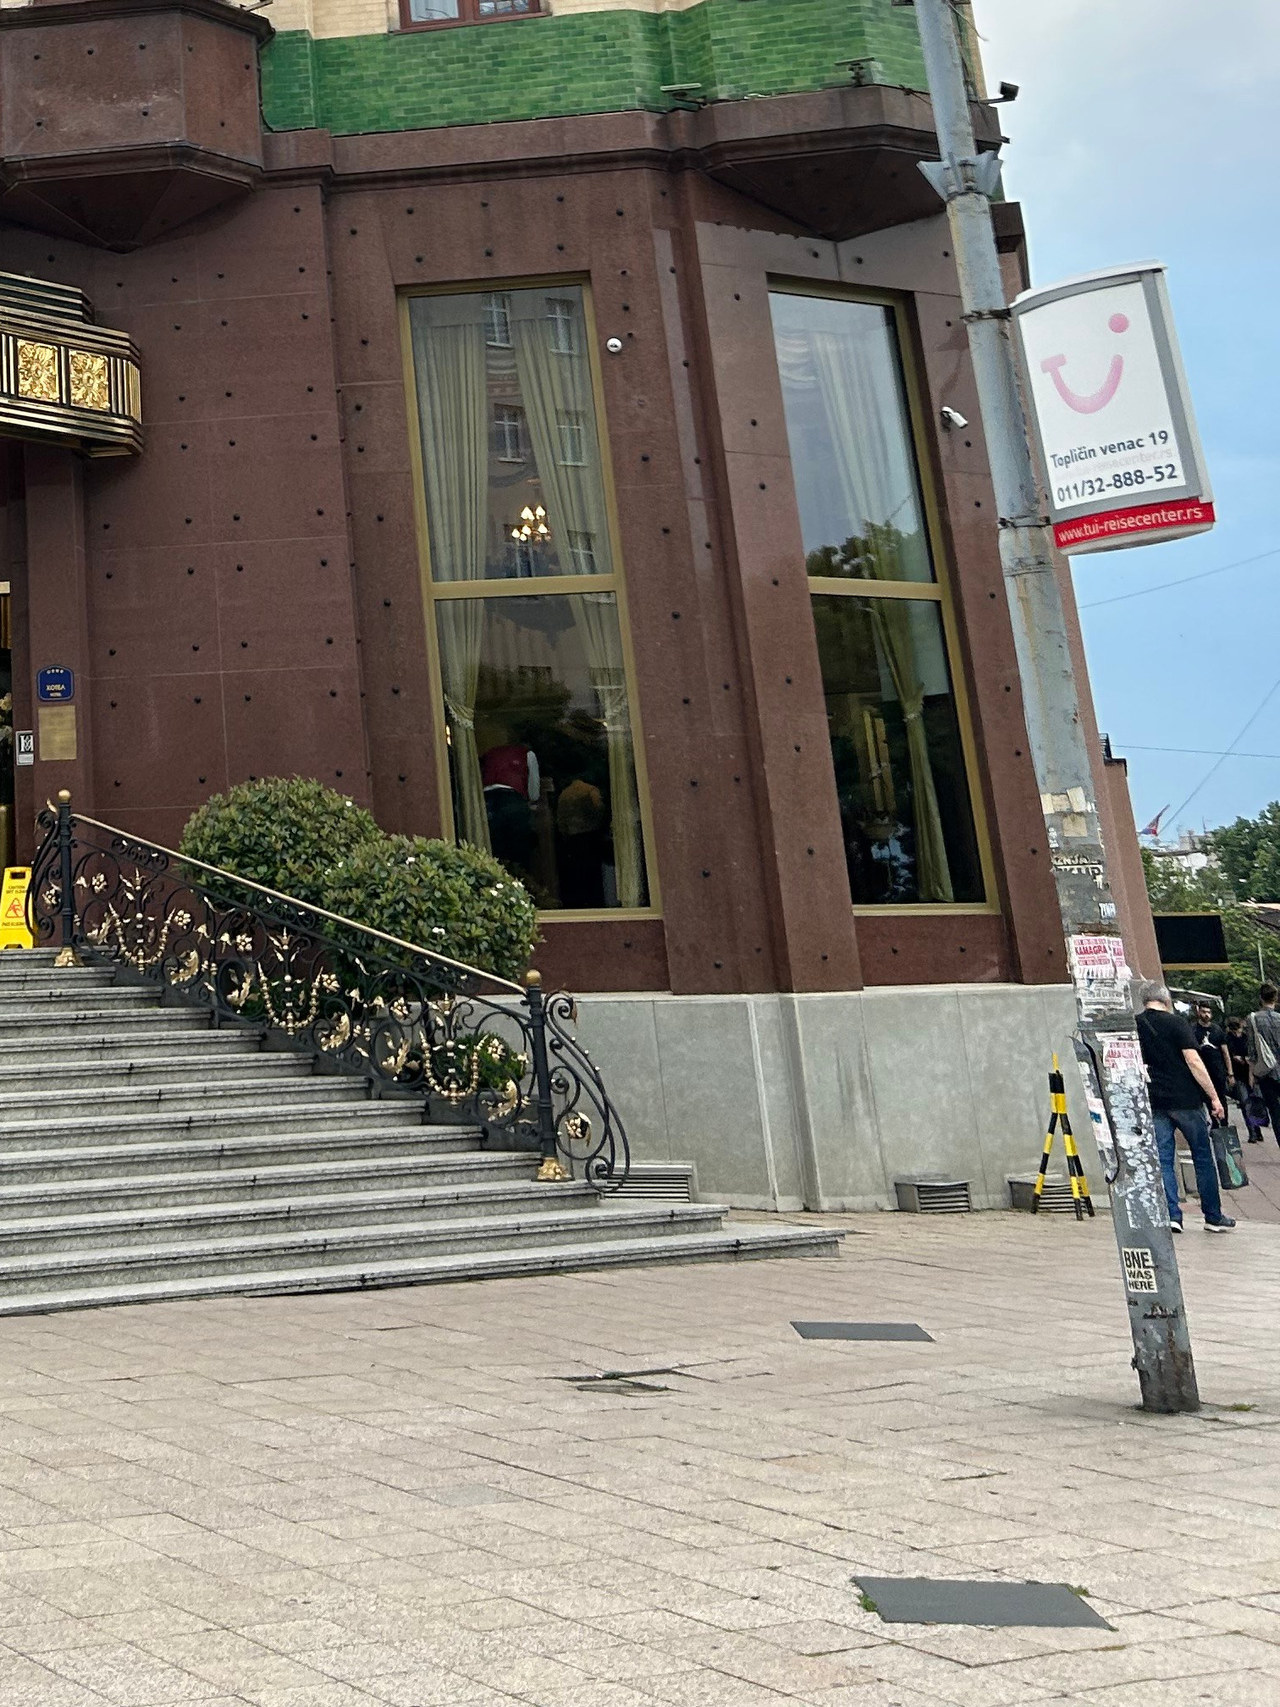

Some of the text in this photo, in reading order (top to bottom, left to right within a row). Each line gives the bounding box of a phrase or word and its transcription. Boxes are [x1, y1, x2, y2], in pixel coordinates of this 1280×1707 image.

[1050, 429, 1169, 469] Topličin venac 19
[1056, 463, 1178, 502] 011/32-888-52
[1058, 506, 1204, 543] www.tui-reisecenter.rs
[1123, 1251, 1151, 1269] BNE
[1127, 1270, 1152, 1279] WAS
[1128, 1280, 1155, 1291] HERE
